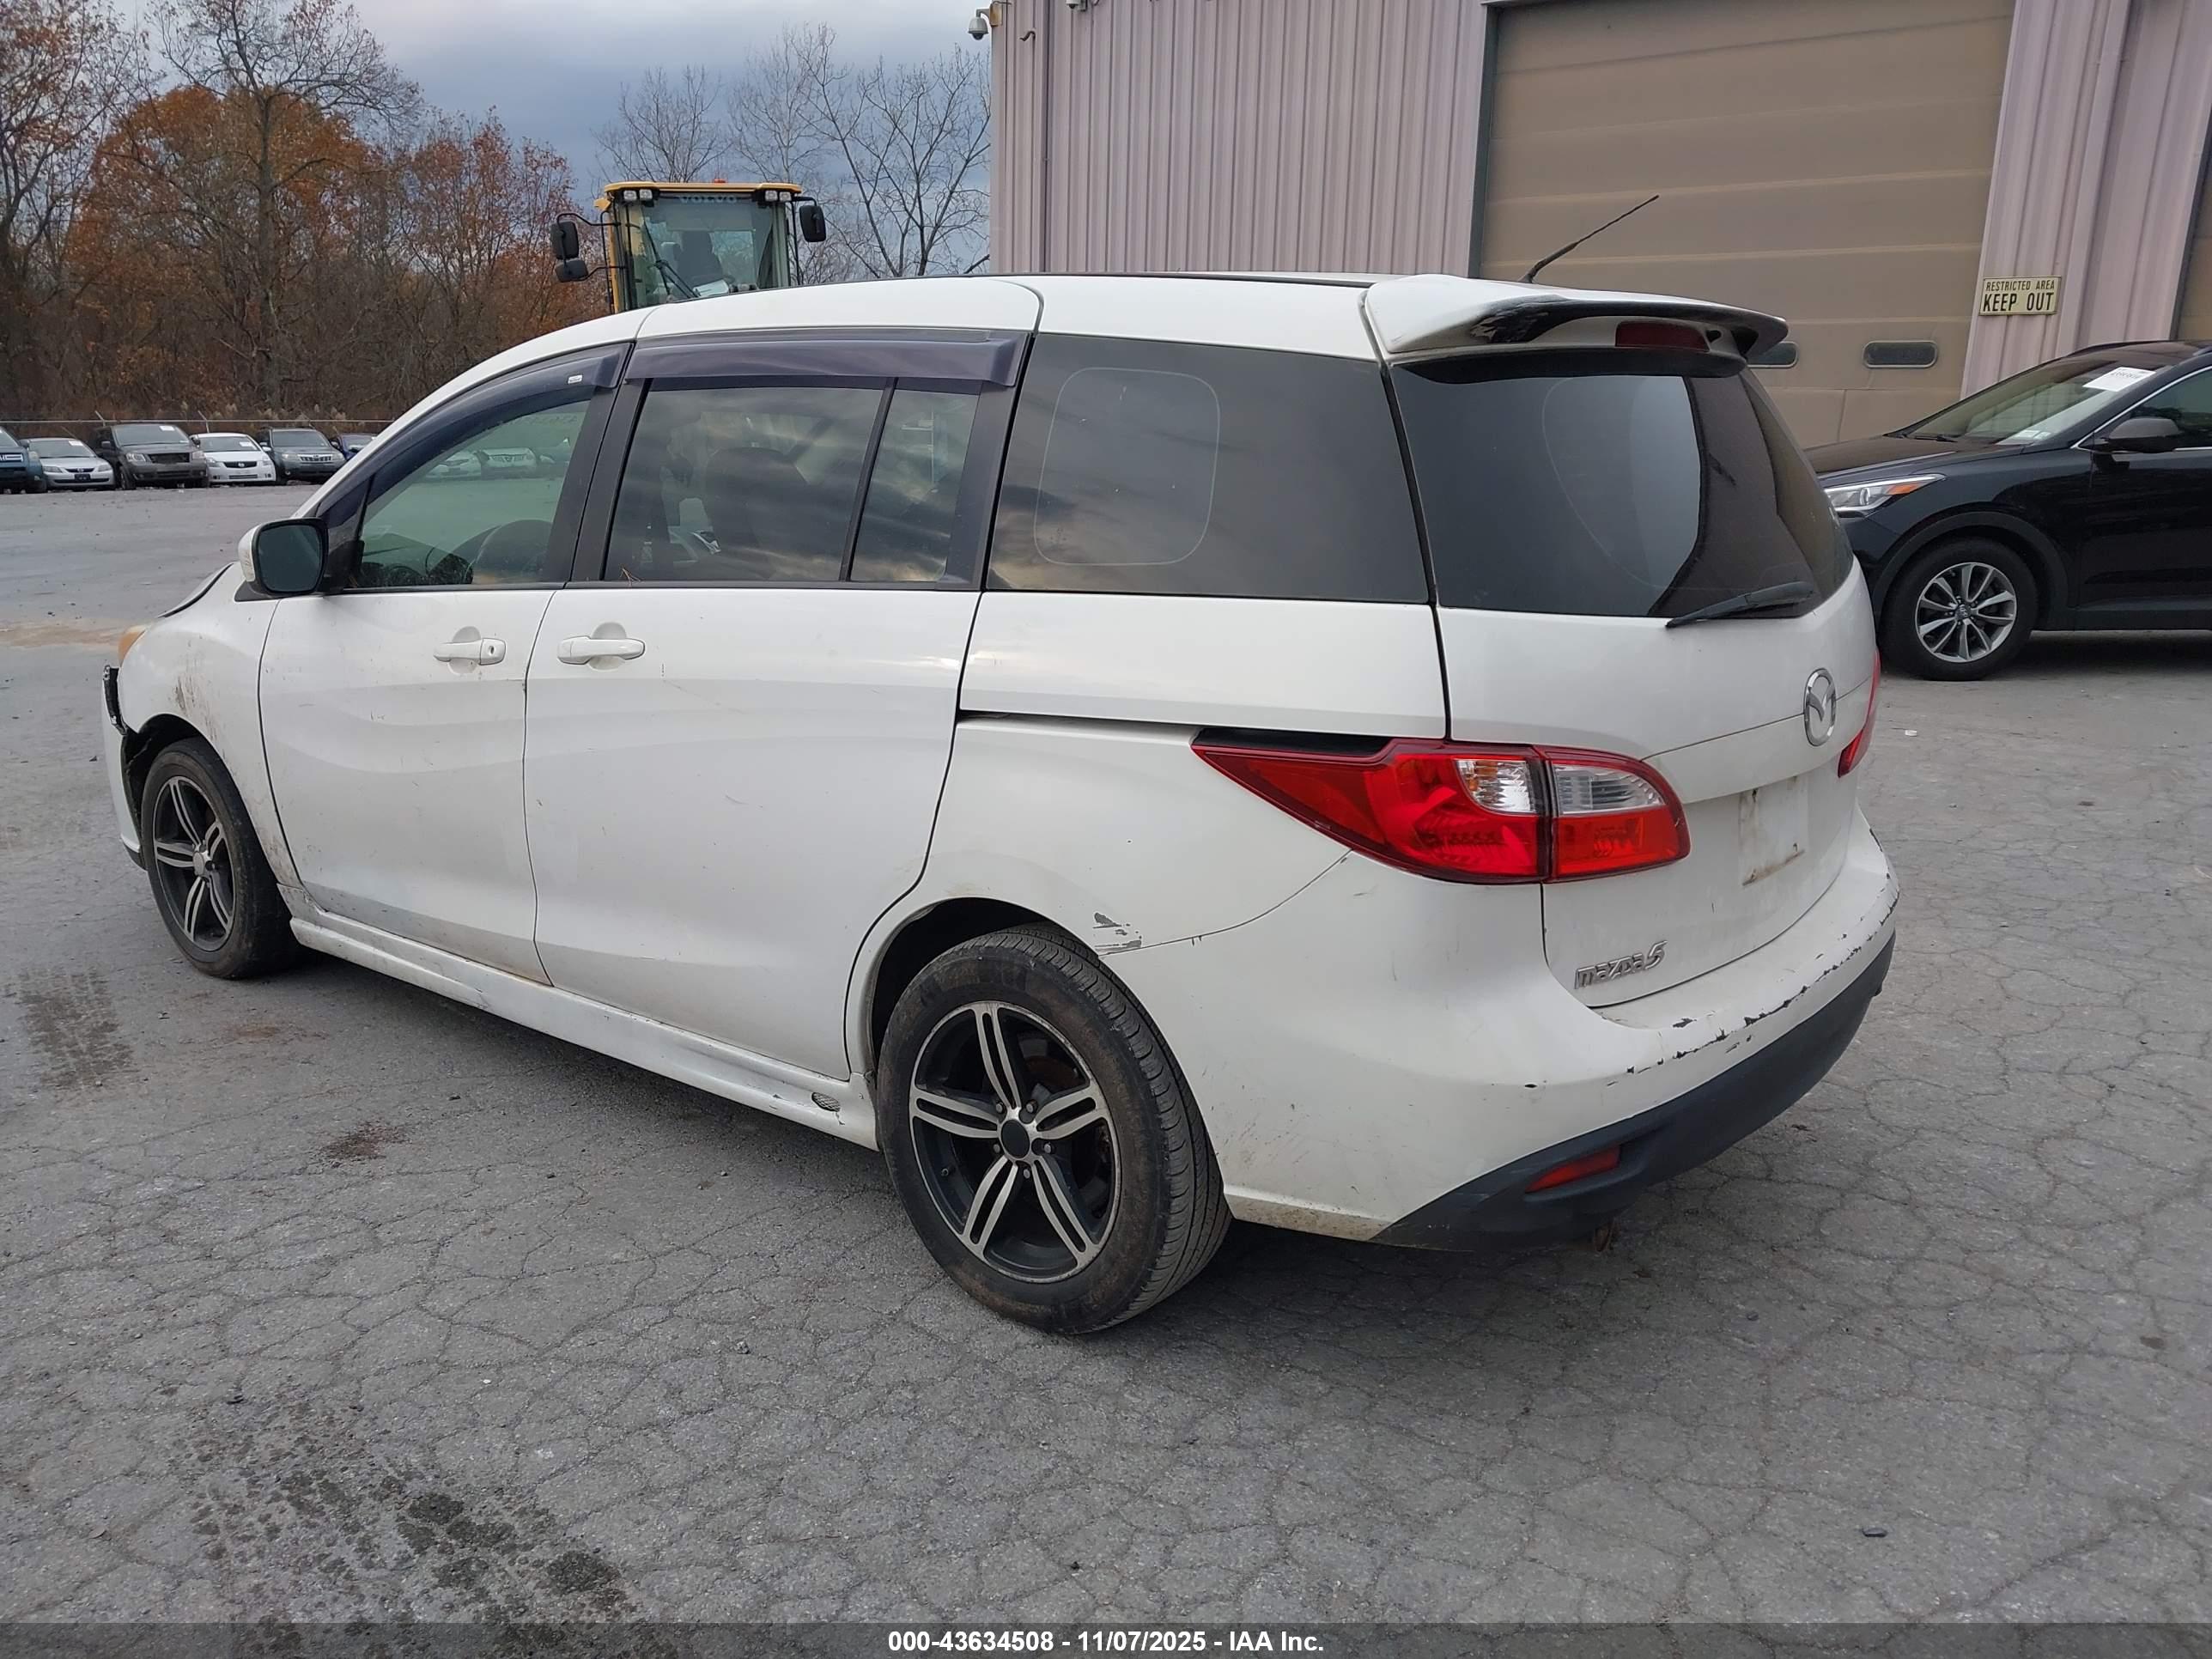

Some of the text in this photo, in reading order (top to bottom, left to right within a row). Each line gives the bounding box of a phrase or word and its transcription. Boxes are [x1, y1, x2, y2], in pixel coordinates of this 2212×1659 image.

[1985, 279, 2055, 292] RESTRICTED AREA
[1983, 292, 2055, 312] KEEP OUT
